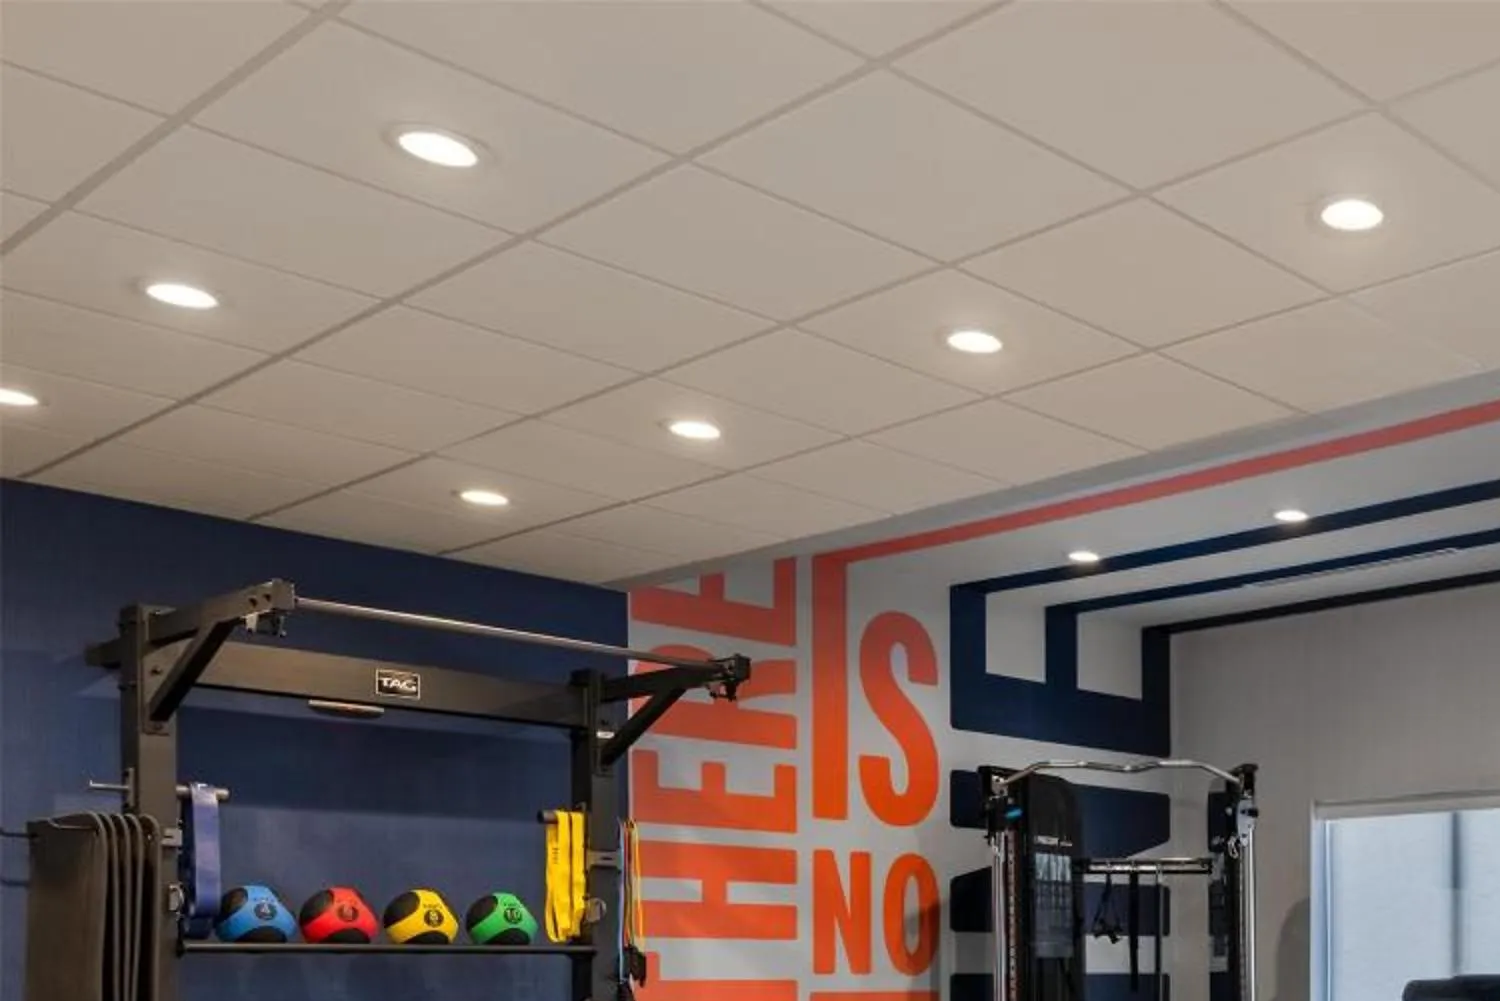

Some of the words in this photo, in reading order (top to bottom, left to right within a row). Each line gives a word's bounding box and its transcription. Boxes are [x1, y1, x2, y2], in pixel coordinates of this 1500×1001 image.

[378, 677, 417, 692] TAG
[812, 552, 939, 828] IS
[812, 849, 940, 976] NO
